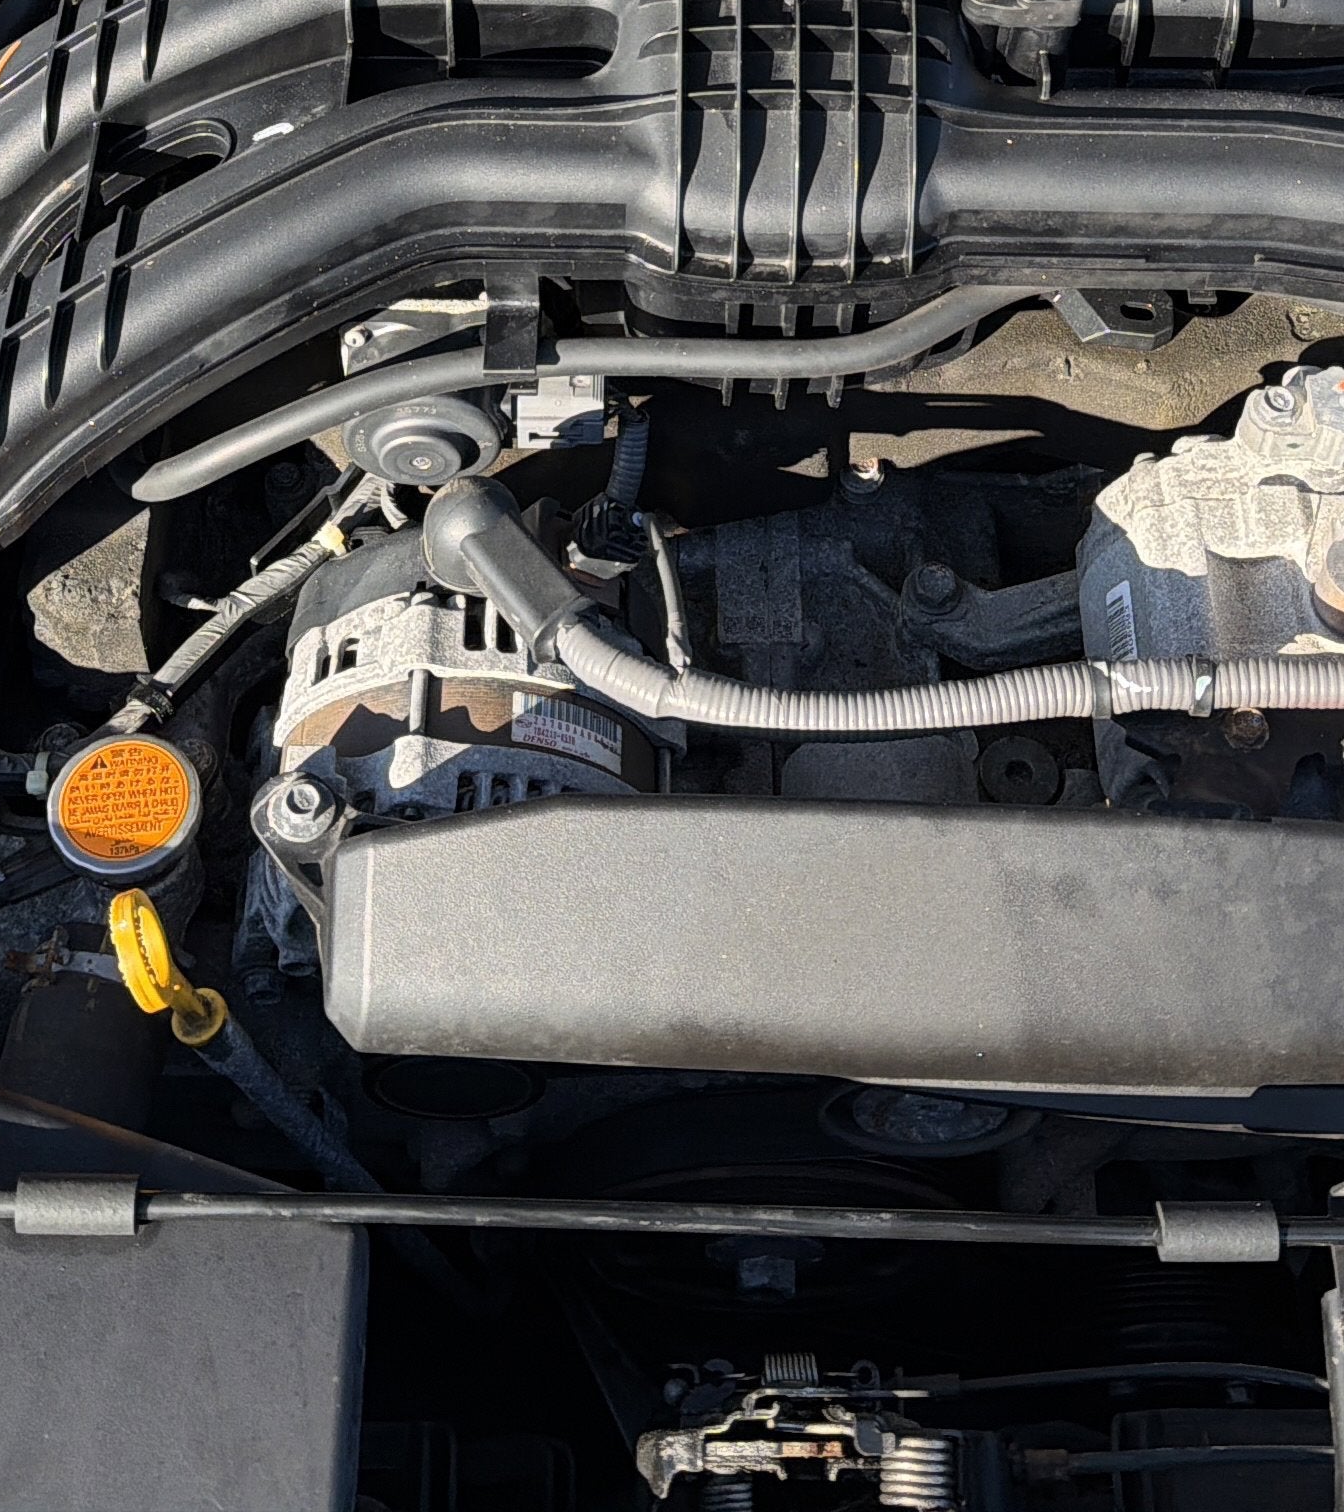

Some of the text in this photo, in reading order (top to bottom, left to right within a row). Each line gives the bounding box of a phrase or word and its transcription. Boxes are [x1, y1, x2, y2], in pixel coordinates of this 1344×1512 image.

[523, 732, 557, 749] DENSO
[110, 757, 159, 767] WARNING
[68, 795, 98, 805] NEVER
[101, 792, 125, 803] OPEN
[128, 789, 156, 799] WHEN
[68, 808, 78, 817] NE
[82, 805, 109, 815] JAMAIS
[84, 820, 163, 838] AVERTISSEMENT
